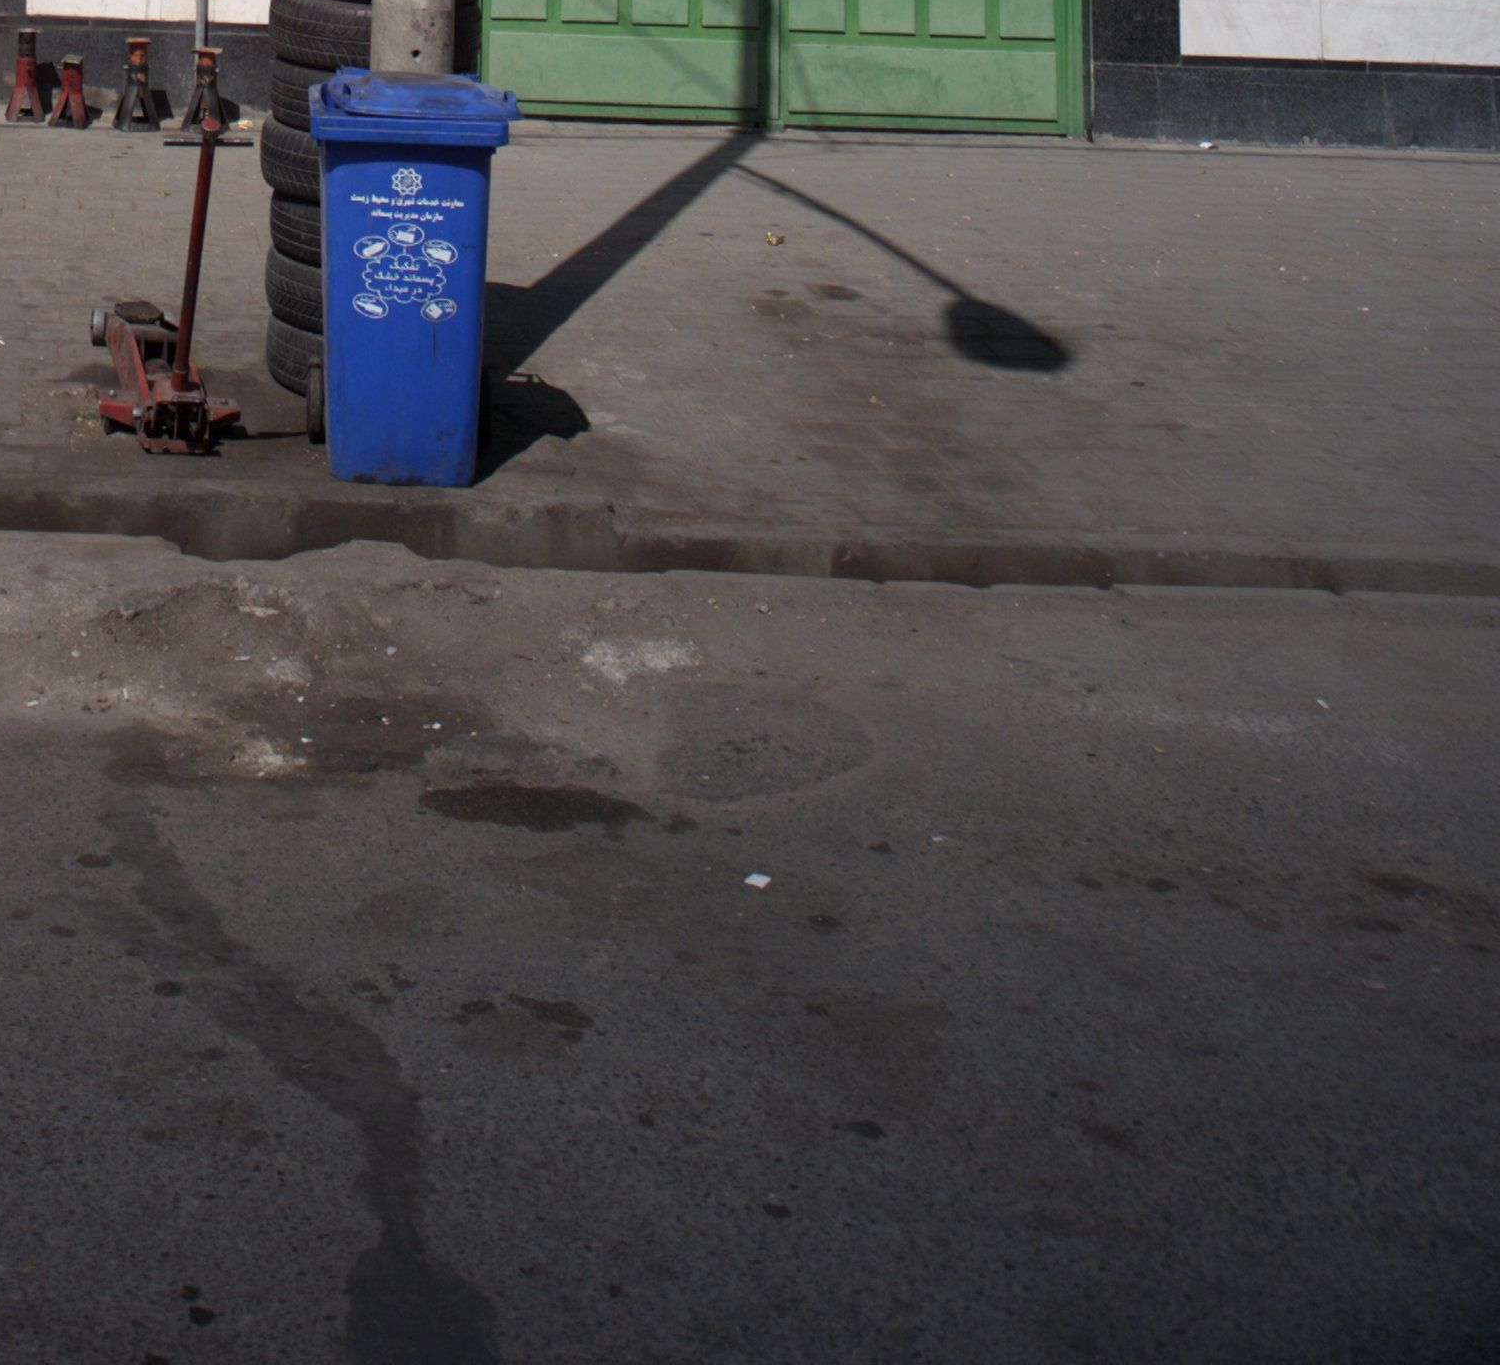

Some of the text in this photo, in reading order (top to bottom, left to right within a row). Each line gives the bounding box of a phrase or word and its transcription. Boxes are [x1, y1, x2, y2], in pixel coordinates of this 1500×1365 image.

[350, 194, 370, 204] زیست
[370, 194, 390, 204] محیط
[395, 197, 415, 207] شهری
[416, 198, 440, 206] خدمات
[440, 199, 465, 208] معاونت
[370, 209, 444, 222] سازمان مدیریت پسماند
[389, 262, 420, 273] تفکیک
[373, 271, 435, 286] پسماند خشک
[411, 287, 423, 296] در
